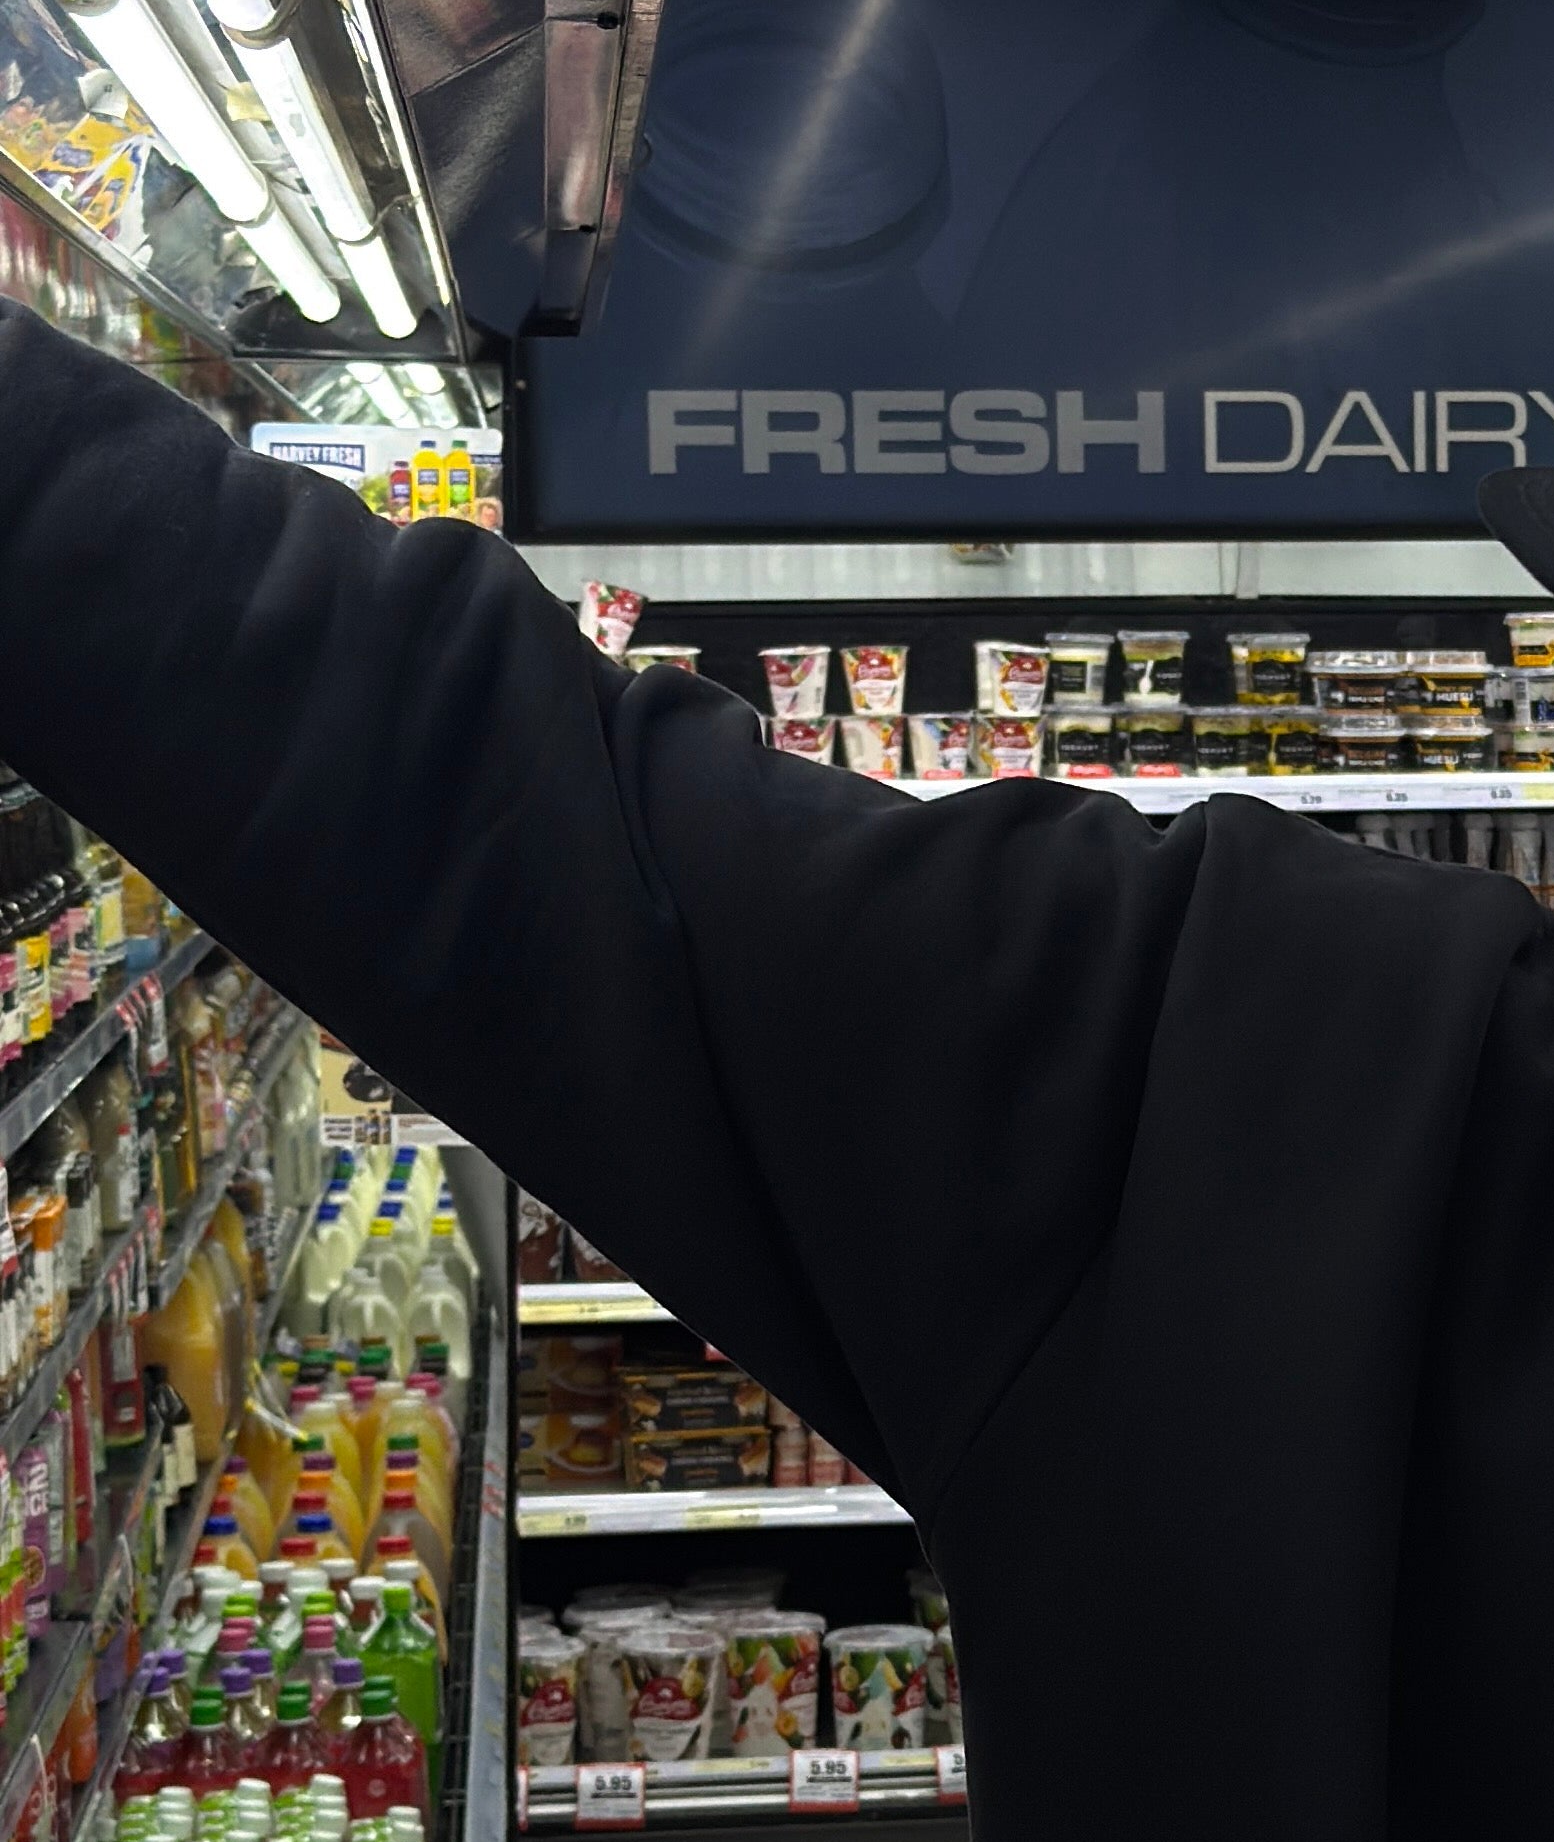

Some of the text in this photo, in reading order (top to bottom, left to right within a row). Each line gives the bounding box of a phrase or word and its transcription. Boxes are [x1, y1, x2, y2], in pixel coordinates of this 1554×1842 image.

[647, 390, 1165, 475] FRESH
[322, 447, 362, 471] FRESH
[811, 1759, 848, 1777] 5.95
[594, 1775, 632, 1792] 5.95
